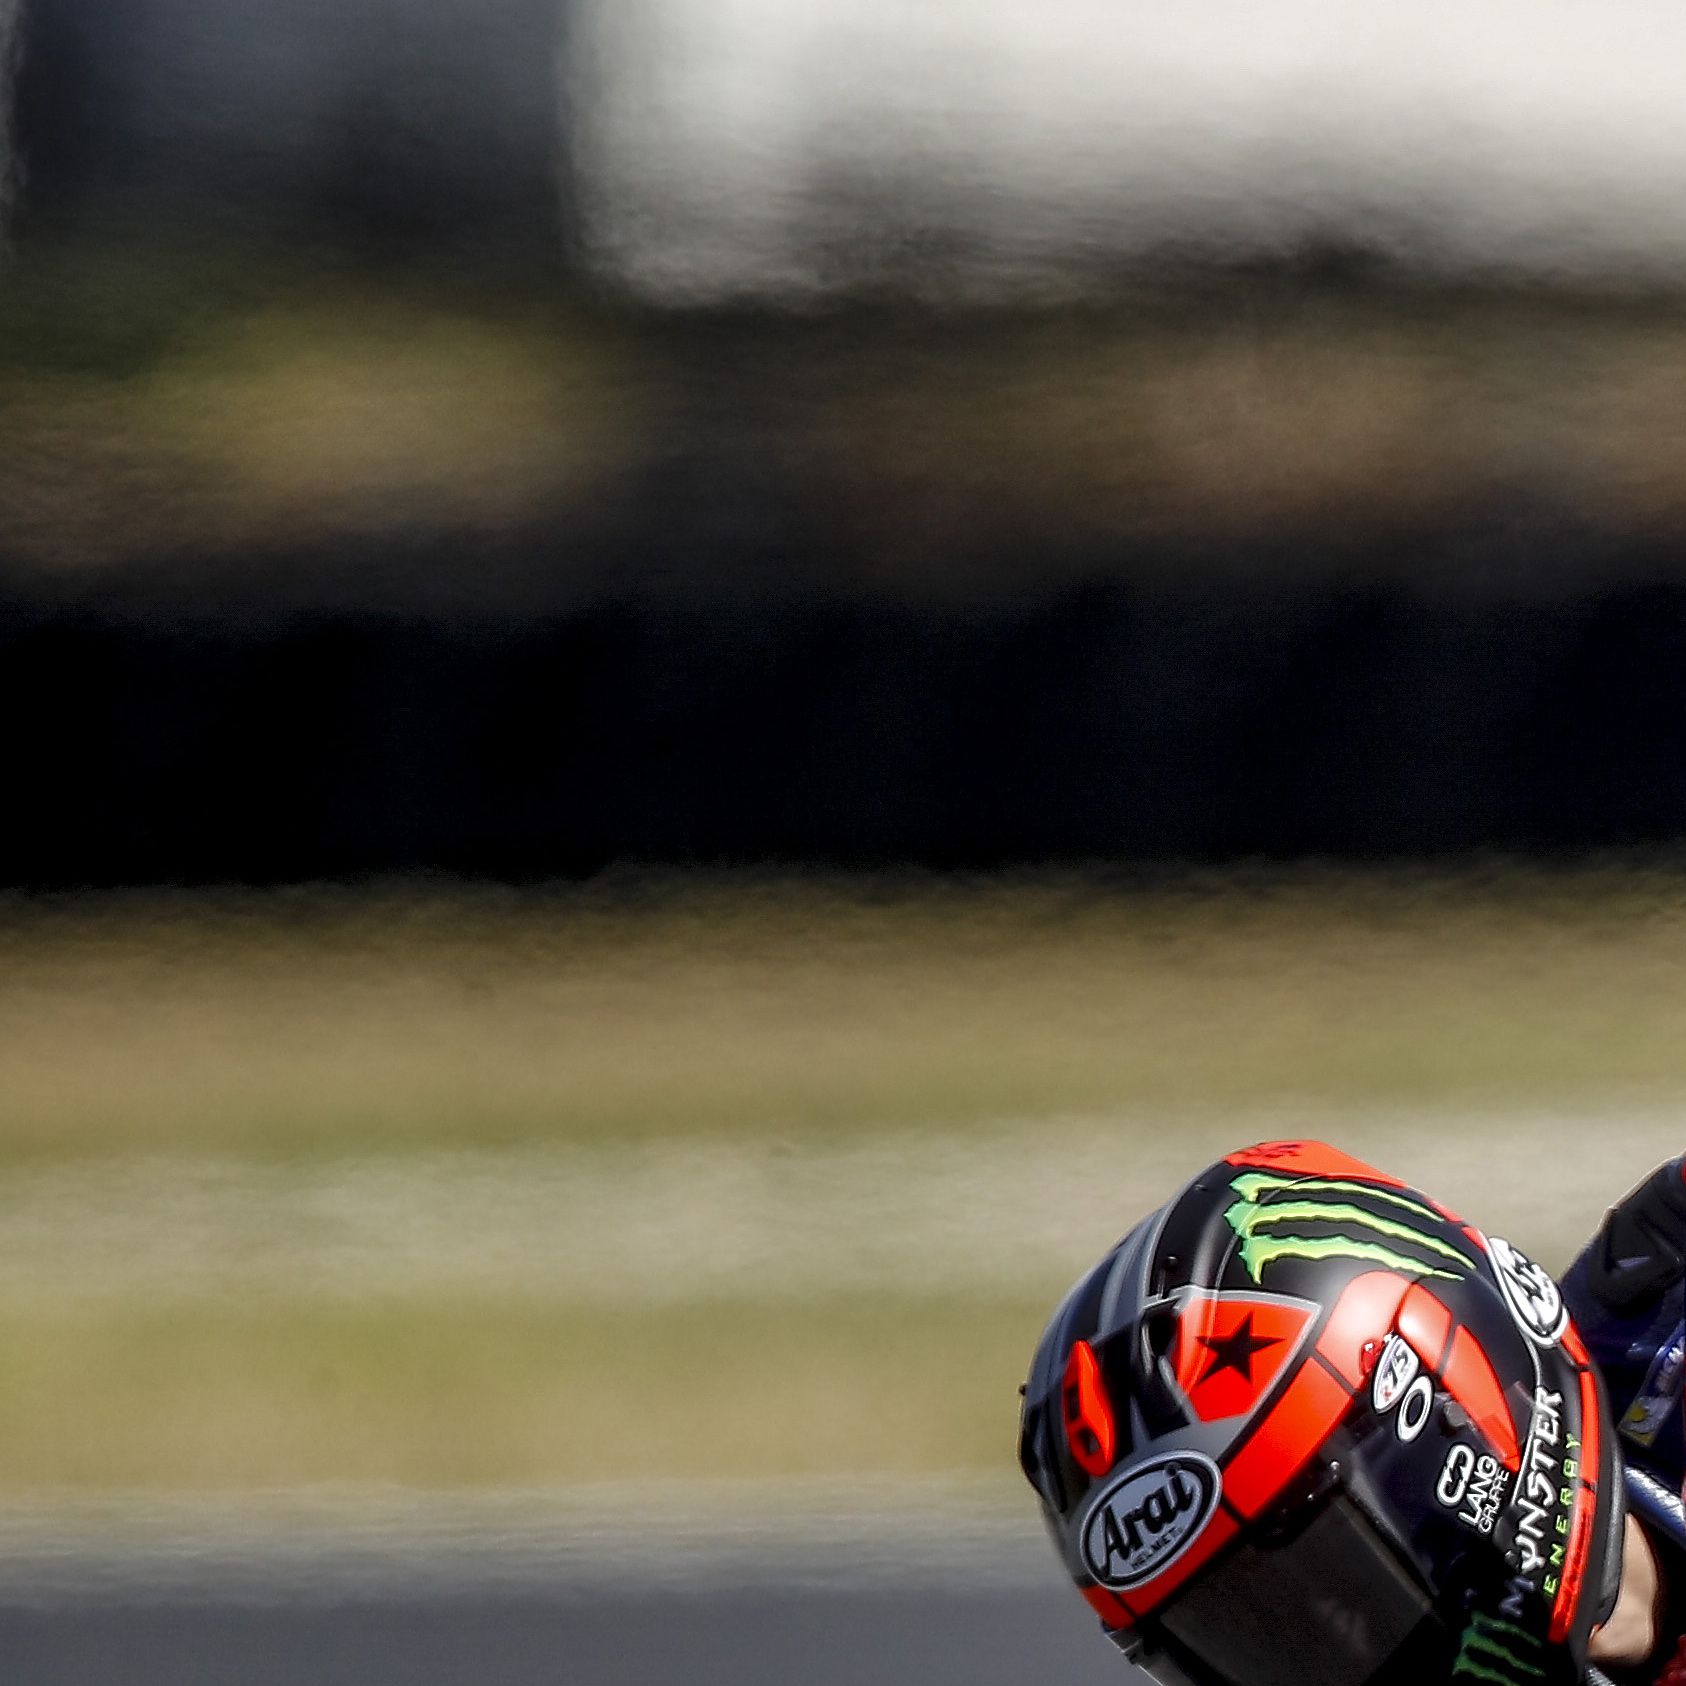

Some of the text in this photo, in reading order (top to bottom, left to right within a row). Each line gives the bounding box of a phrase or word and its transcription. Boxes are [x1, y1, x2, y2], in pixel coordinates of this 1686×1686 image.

[1099, 1463, 1193, 1577] Arai
[1458, 1455, 1497, 1527] LANG
[1478, 1467, 1510, 1533] GRUPPE
[1500, 1385, 1562, 1617] MONSTER
[1544, 1433, 1581, 1598] ENERGY
